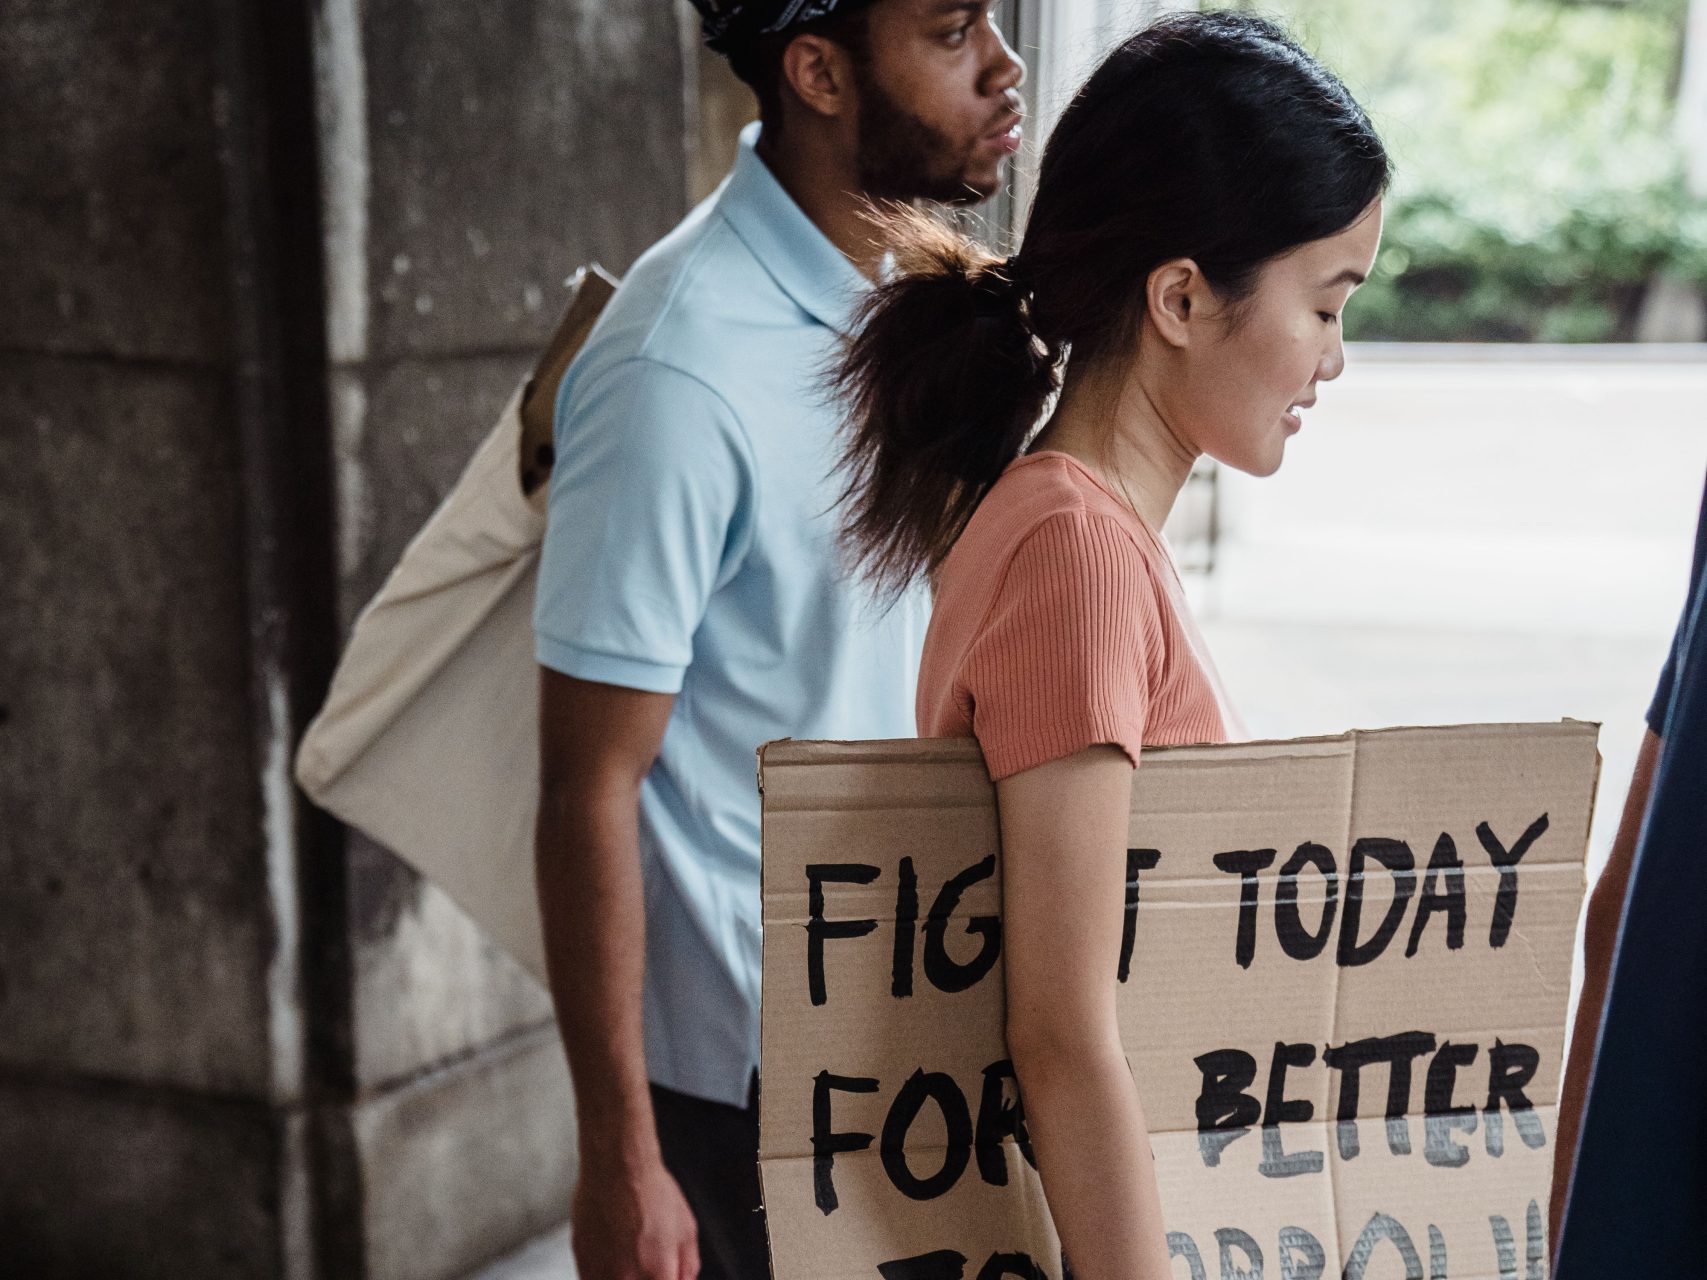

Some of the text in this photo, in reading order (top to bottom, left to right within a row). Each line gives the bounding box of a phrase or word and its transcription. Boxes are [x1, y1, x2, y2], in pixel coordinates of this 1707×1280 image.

[805, 812, 1549, 1006] FIGT TODAY
[810, 1058, 1039, 1216] FOR
[1193, 1030, 1547, 1178] BETTER
